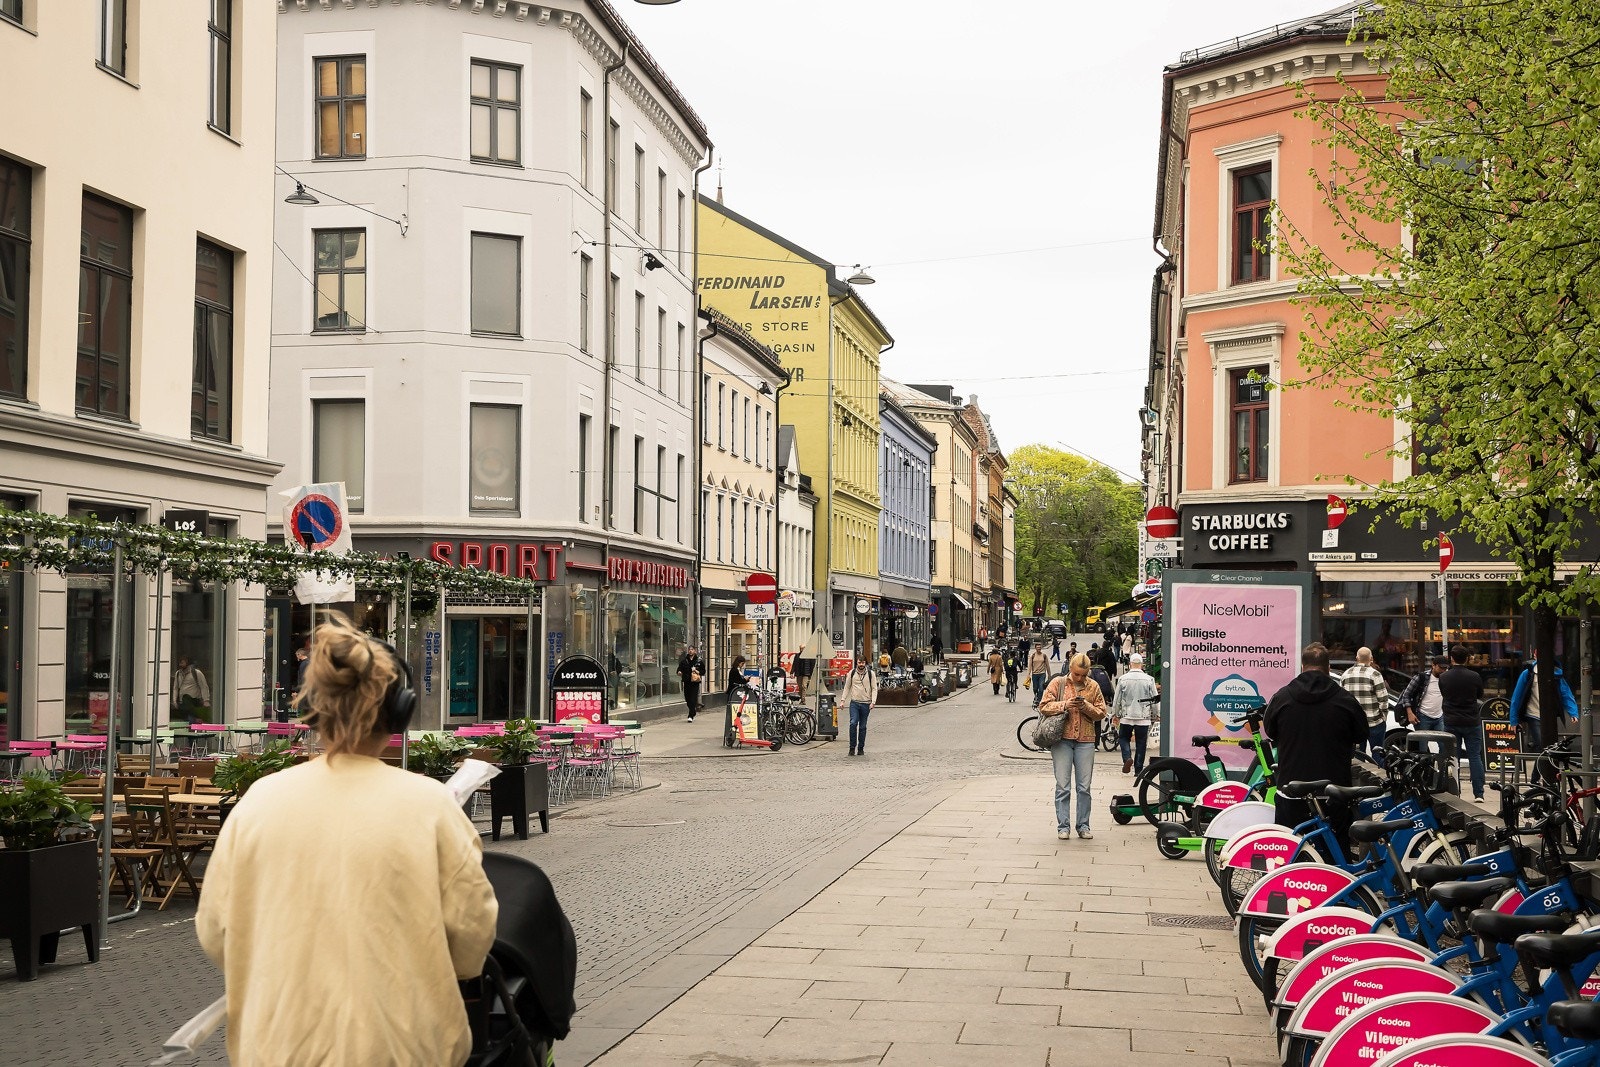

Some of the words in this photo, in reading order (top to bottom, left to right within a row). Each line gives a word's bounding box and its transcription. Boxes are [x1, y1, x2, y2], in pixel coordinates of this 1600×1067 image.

[697, 276, 785, 289] FERDINAND
[750, 291, 813, 309] LARSEN
[762, 322, 809, 331] STORE
[174, 520, 196, 531] LOS
[1191, 512, 1289, 531] STARBUCKS
[1208, 533, 1270, 551] COFFEE
[430, 541, 563, 581] SPORT
[608, 556, 635, 582] OSLO
[635, 560, 689, 589] SPORTSLAGER
[1182, 628, 1227, 640] Billigste
[1181, 642, 1288, 656] mobilabonnement,
[1181, 655, 1219, 667] måned
[1220, 657, 1247, 668] etter
[1249, 657, 1290, 669] måned!
[556, 691, 602, 701] LUNCH
[556, 701, 602, 711] DEALS
[1234, 703, 1253, 711] DATA
[1485, 723, 1507, 732] DROP
[1253, 842, 1288, 851] foodora
[1284, 878, 1328, 893] foodora
[1307, 923, 1357, 936] foodora
[1331, 954, 1359, 963] foodora
[1353, 979, 1384, 990] foodora
[1342, 992, 1353, 1003] Vi
[1335, 1005, 1350, 1017] dit
[1377, 1017, 1411, 1027] foodora
[1365, 1031, 1378, 1043] Vi
[1358, 1046, 1375, 1059] dit
